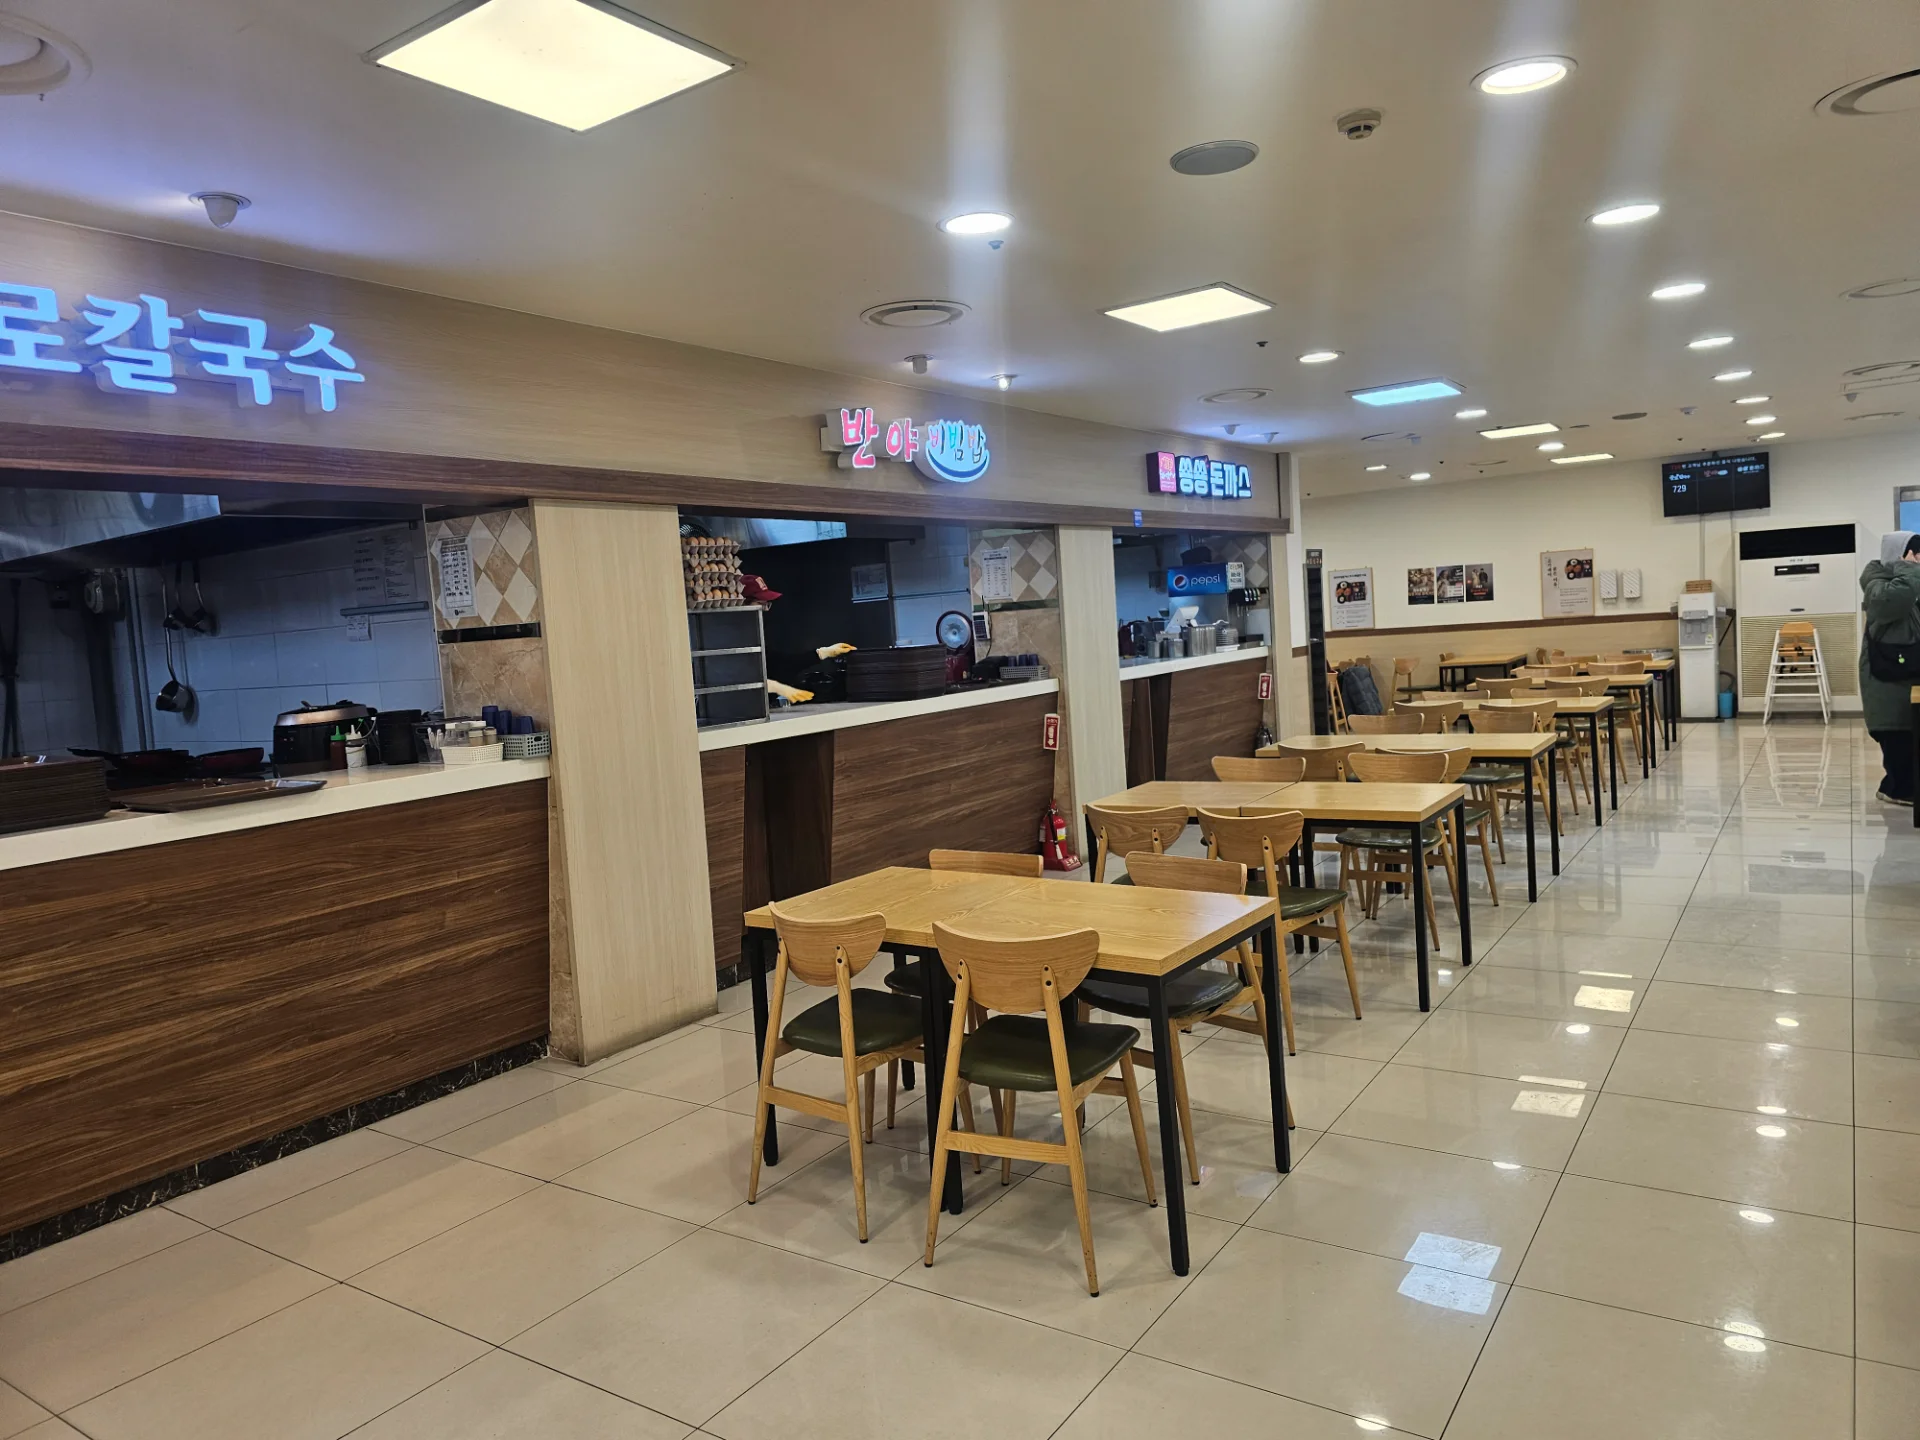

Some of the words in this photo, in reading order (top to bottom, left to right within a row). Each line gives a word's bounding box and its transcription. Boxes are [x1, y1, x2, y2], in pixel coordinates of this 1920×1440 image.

[840, 407, 920, 469] 반야
[1672, 484, 1687, 493] 729
[1190, 573, 1221, 587] pepsi
